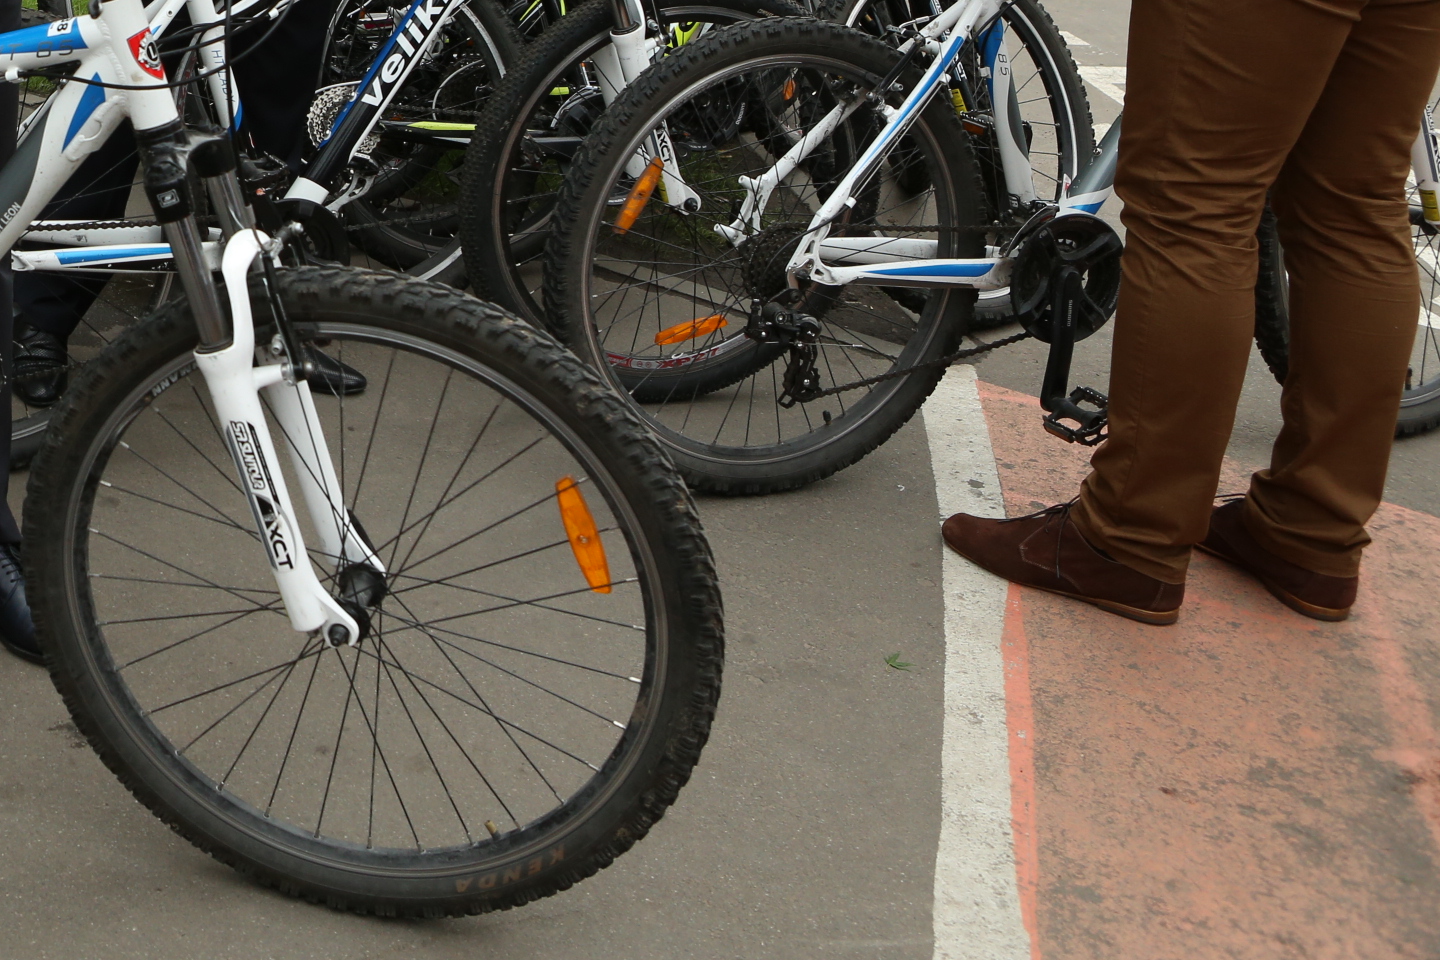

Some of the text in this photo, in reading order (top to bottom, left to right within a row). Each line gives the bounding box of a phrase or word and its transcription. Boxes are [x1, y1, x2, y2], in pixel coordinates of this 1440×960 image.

[36, 40, 74, 59] 85
[997, 53, 1010, 76] 85
[0, 201, 22, 226] LEON
[268, 521, 294, 571] XCT
